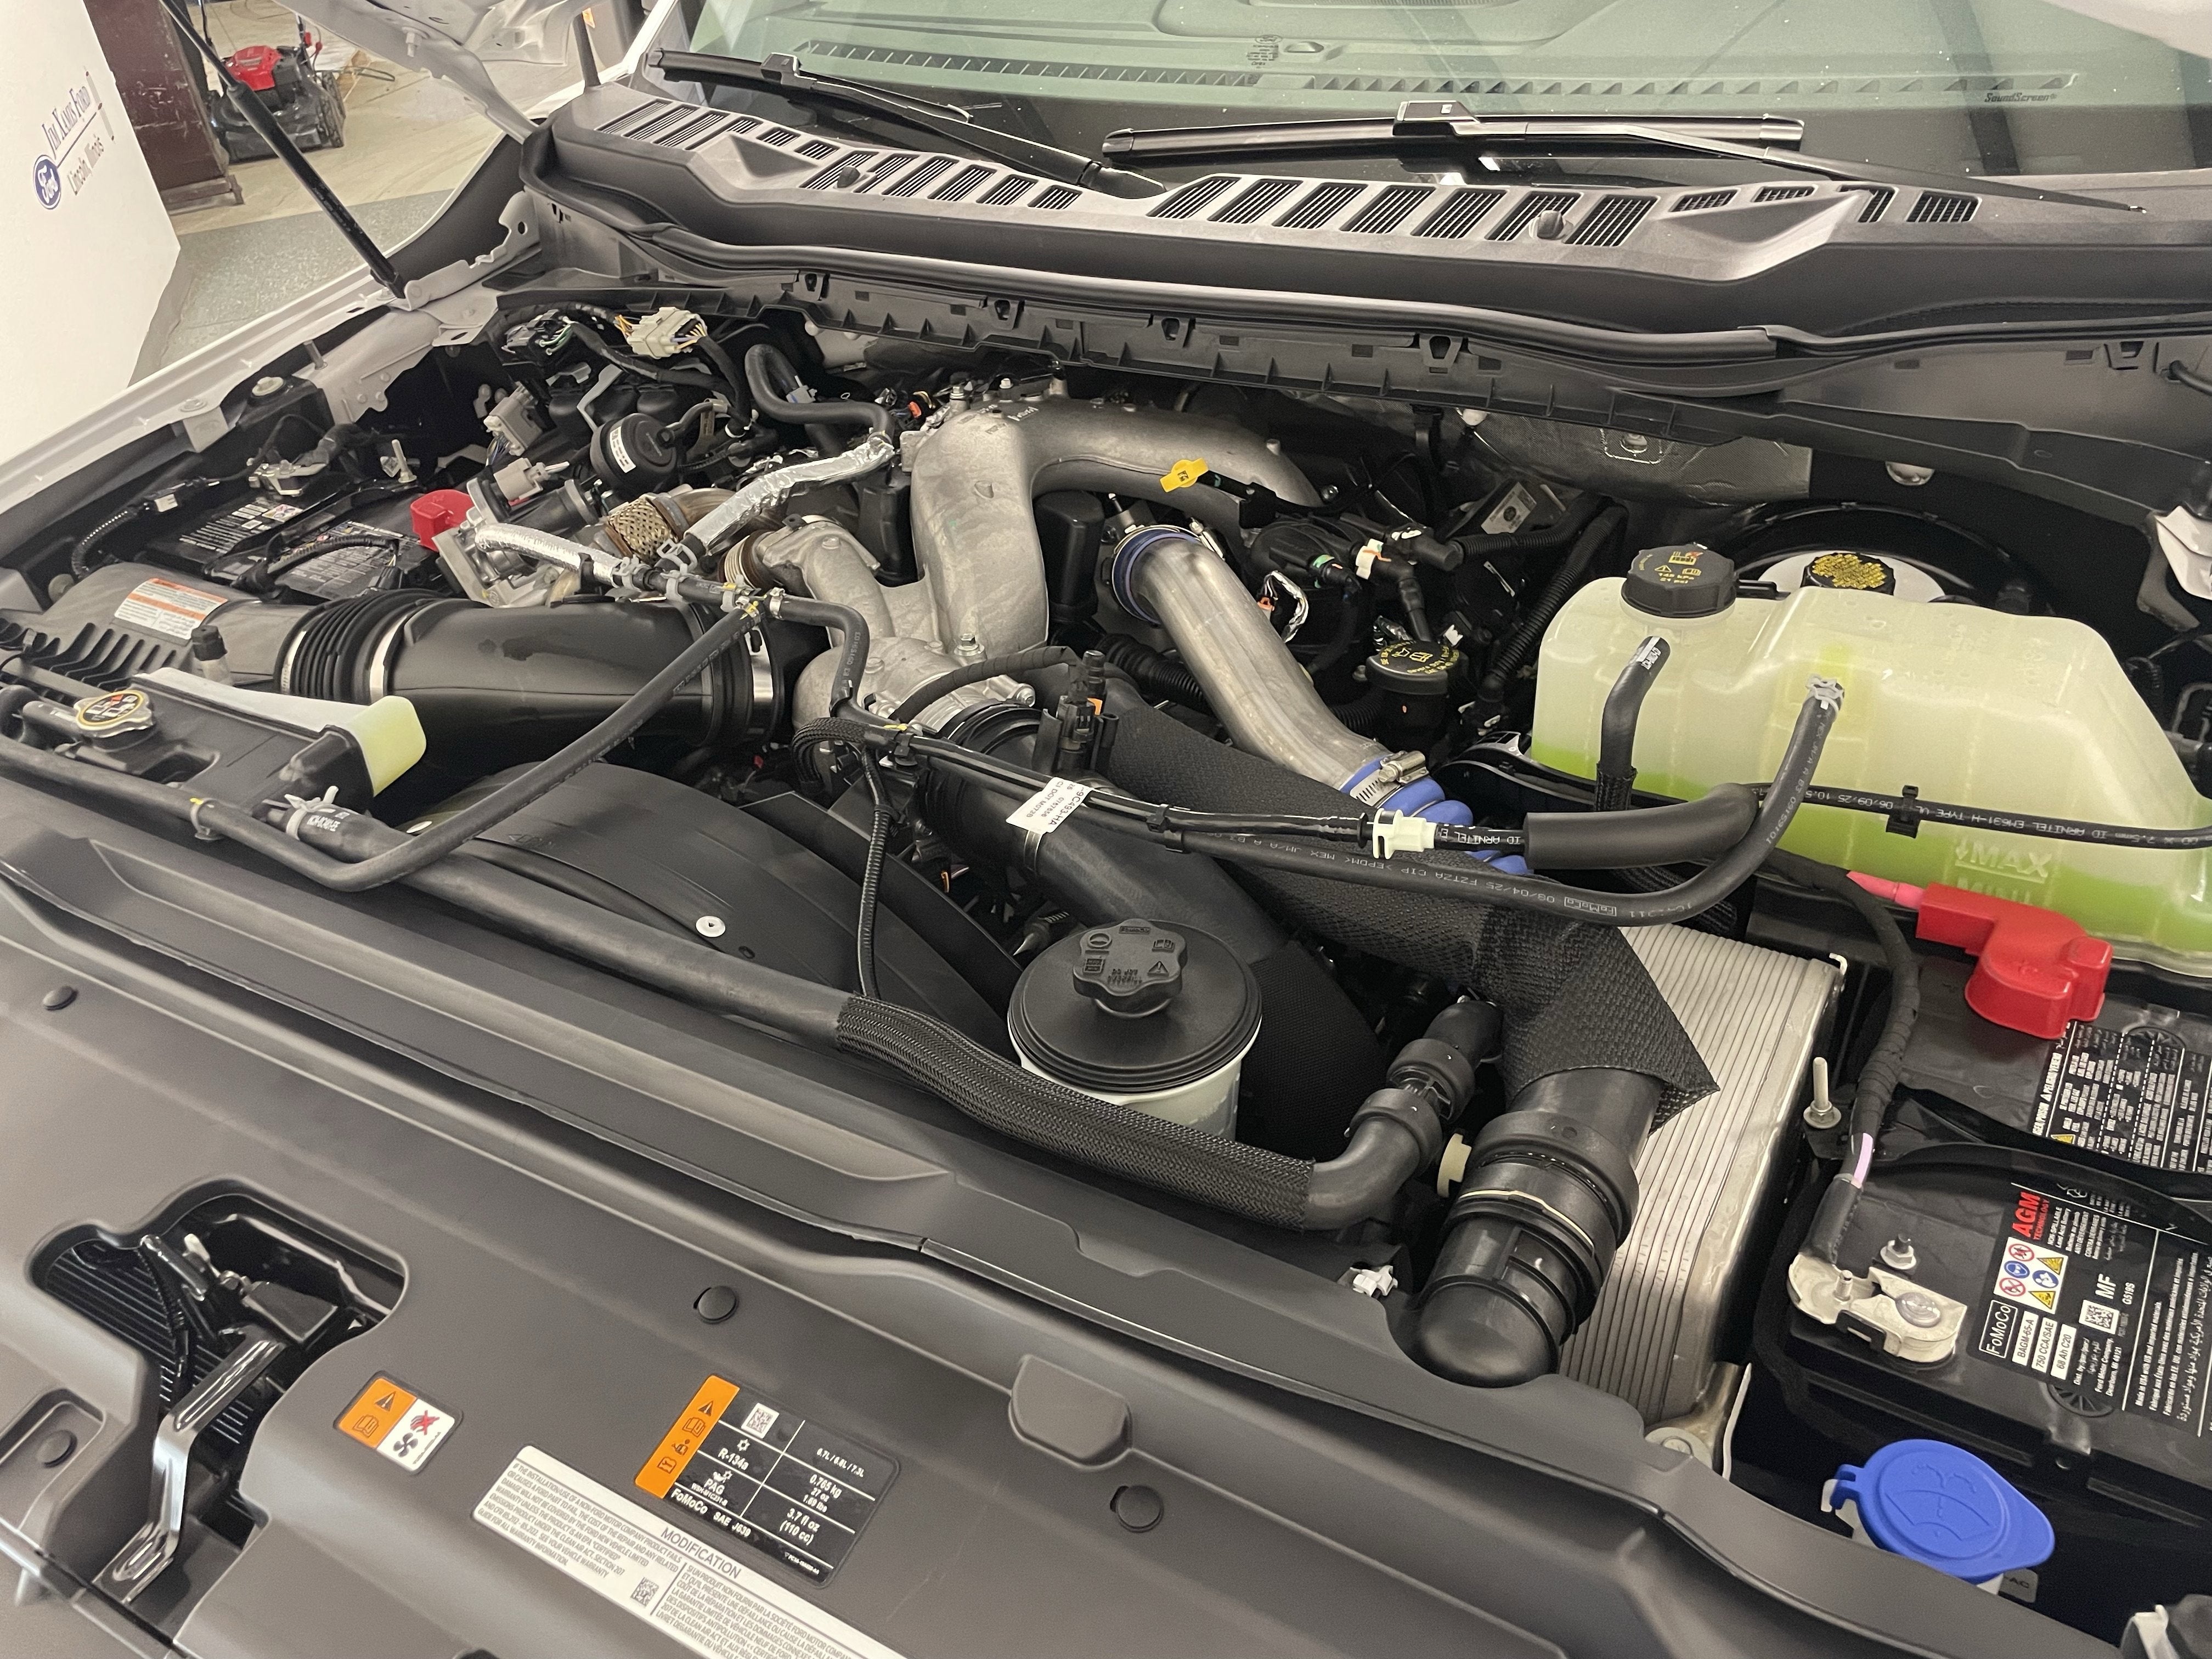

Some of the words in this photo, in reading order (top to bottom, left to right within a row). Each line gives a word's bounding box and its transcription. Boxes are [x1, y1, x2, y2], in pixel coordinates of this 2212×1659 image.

[37, 165, 59, 204] Ford
[1936, 809, 1965, 820] TYPE
[1453, 831, 1500, 846] ARNITEL
[1506, 835, 1521, 845] ID
[1971, 842, 2052, 877] MAX
[2011, 1190, 2041, 1238] AGM
[2033, 1198, 2051, 1241] TECHNOLOGY
[2094, 1273, 2118, 1301] MF
[1984, 1301, 2012, 1355] FoMoCo
[2015, 1317, 2035, 1359] BAGM-65-A
[2038, 1320, 2055, 1355] CCA/SAE
[2061, 1333, 2072, 1350] C20
[2035, 1353, 2046, 1369] 750
[2058, 1347, 2068, 1361] Ah
[716, 1447, 752, 1471] R-134a
[702, 1477, 727, 1496] PAG
[808, 1473, 833, 1492] 0.765
[827, 1483, 845, 1499] kg
[809, 1486, 822, 1498] 27
[818, 1492, 830, 1502] oz
[517, 1465, 528, 1475] THE
[568, 1494, 577, 1503] OF
[602, 1514, 623, 1530] MOTOR
[619, 1524, 646, 1543] COMPANY
[642, 1538, 668, 1555] PRODUCT
[665, 1551, 682, 1564] FAILS
[669, 1487, 711, 1516] FoMoCo
[712, 1510, 733, 1527] SAE
[730, 1520, 753, 1538] J639
[801, 1493, 819, 1507] 1.69
[815, 1500, 830, 1513] lbs
[506, 1469, 516, 1479] OR
[513, 1473, 534, 1488] CAUSES
[534, 1486, 550, 1498] FORD
[546, 1493, 562, 1505] PART
[559, 1500, 569, 1509] TO
[577, 1510, 589, 1521] THE
[586, 1516, 602, 1528] COST
[599, 1523, 608, 1532] OF
[606, 1527, 619, 1538] THE
[615, 1533, 636, 1548] REPAIR
[633, 1543, 646, 1554] AND
[644, 1549, 657, 1561] ANY
[654, 1555, 679, 1573] RELATED
[777, 1519, 802, 1538] (110
[796, 1528, 816, 1546] cc)
[785, 1507, 804, 1522] 3.7
[799, 1514, 811, 1526] fl
[806, 1520, 822, 1533] oz
[660, 1526, 742, 1579] MODIFICATION
